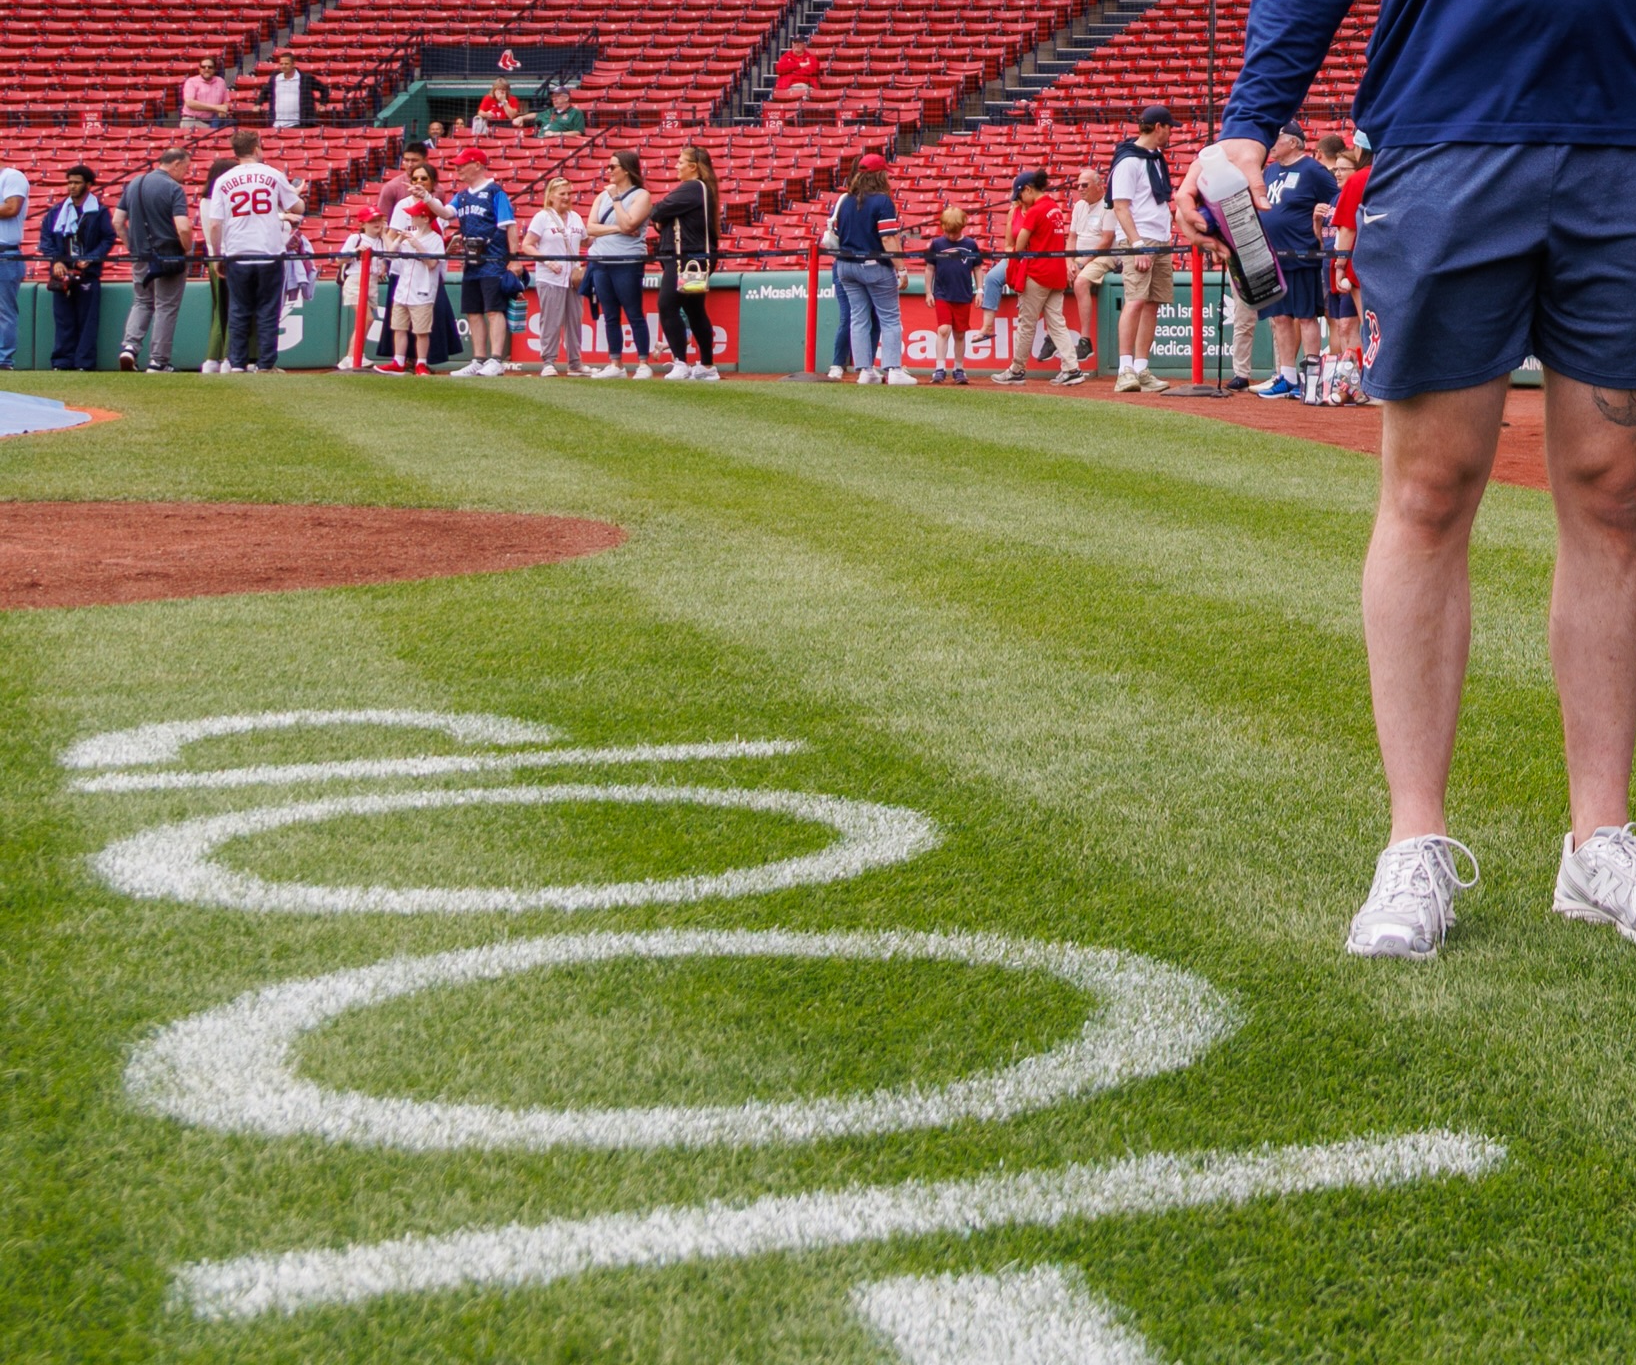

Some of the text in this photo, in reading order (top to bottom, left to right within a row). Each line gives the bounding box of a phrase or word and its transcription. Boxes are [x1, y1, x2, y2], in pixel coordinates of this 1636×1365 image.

[220, 173, 277, 195] ROBERTSON
[230, 188, 272, 217] 26
[1177, 303, 1213, 318] Isrel
